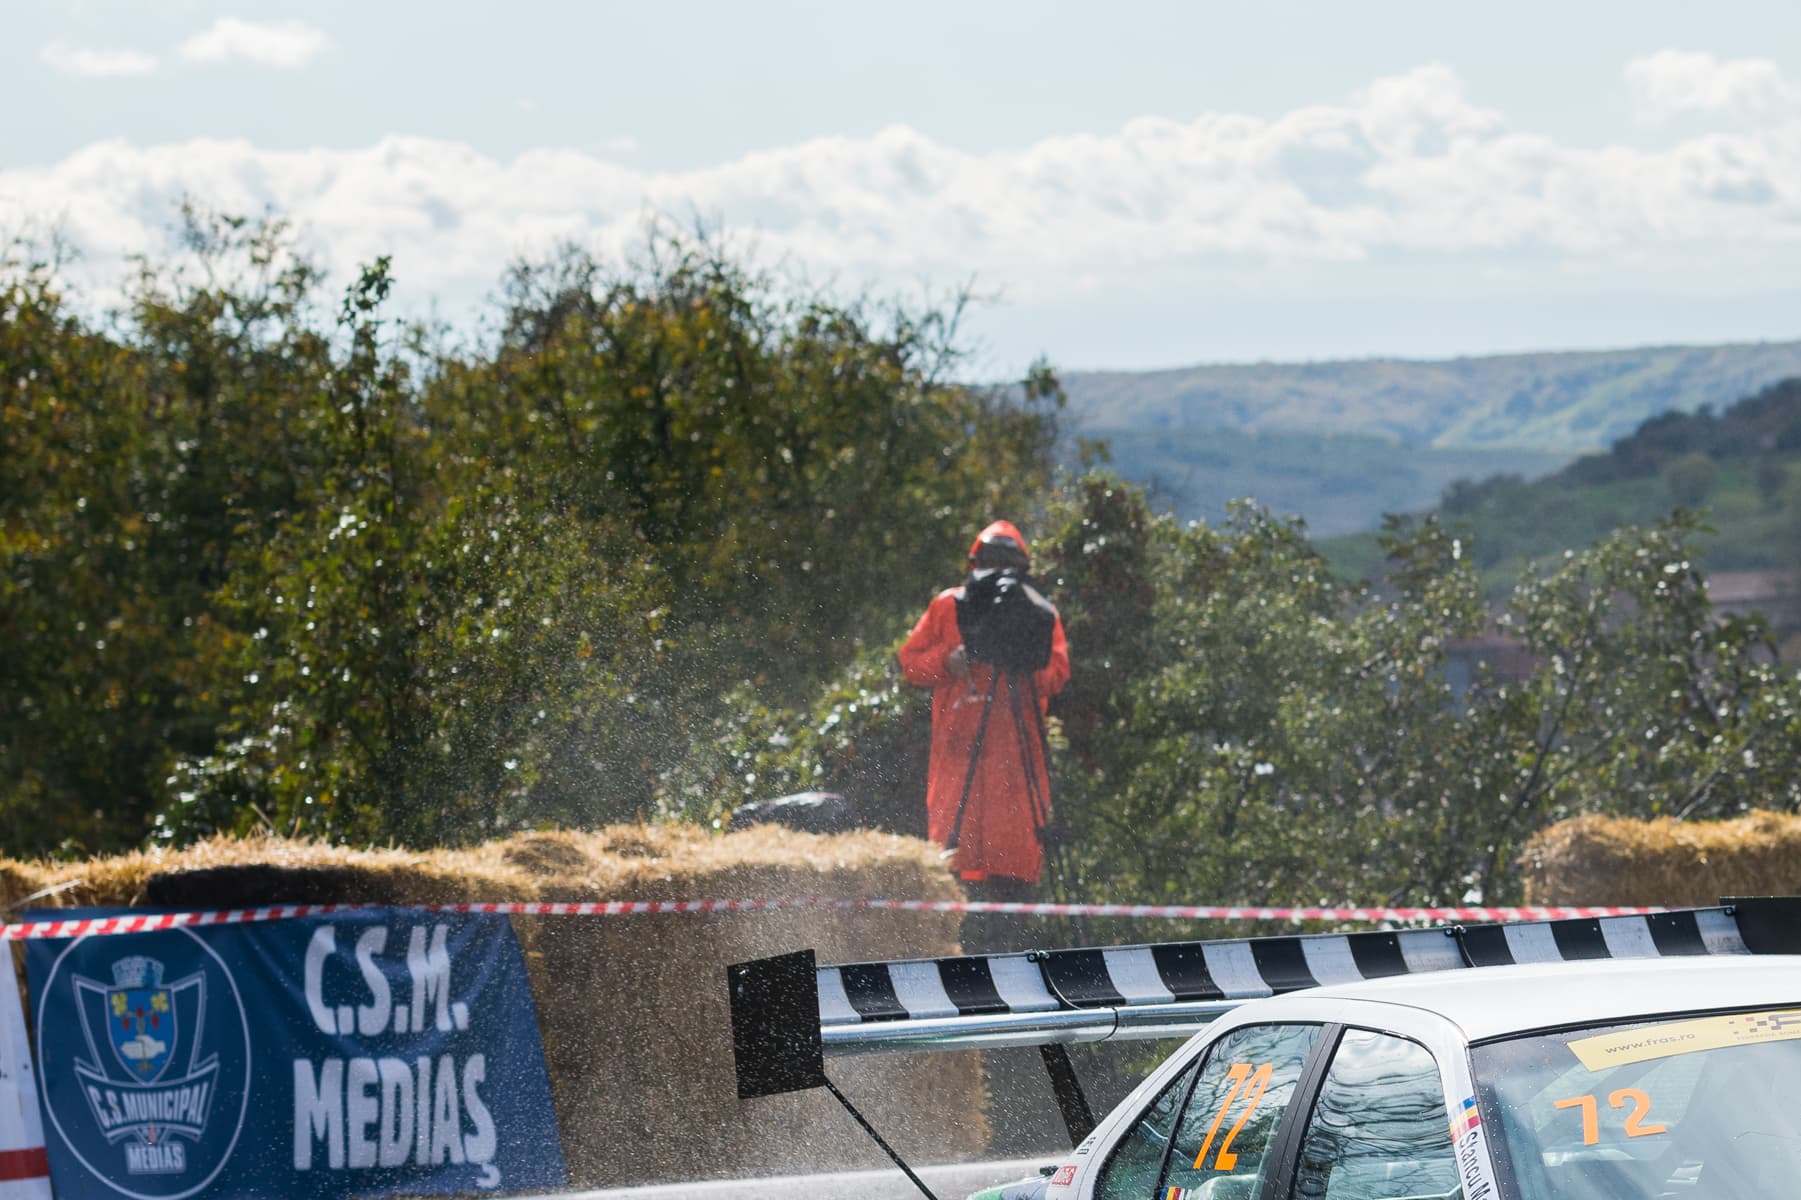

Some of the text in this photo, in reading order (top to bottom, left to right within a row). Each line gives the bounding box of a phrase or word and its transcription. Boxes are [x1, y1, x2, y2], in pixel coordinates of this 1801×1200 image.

[304, 924, 469, 1036] C.S.M.
[1605, 1032, 1696, 1055] www.fras.ro
[1192, 1062, 1273, 1171] 72
[1552, 1087, 1668, 1147] 72
[1459, 1130, 1481, 1189] Stancu
